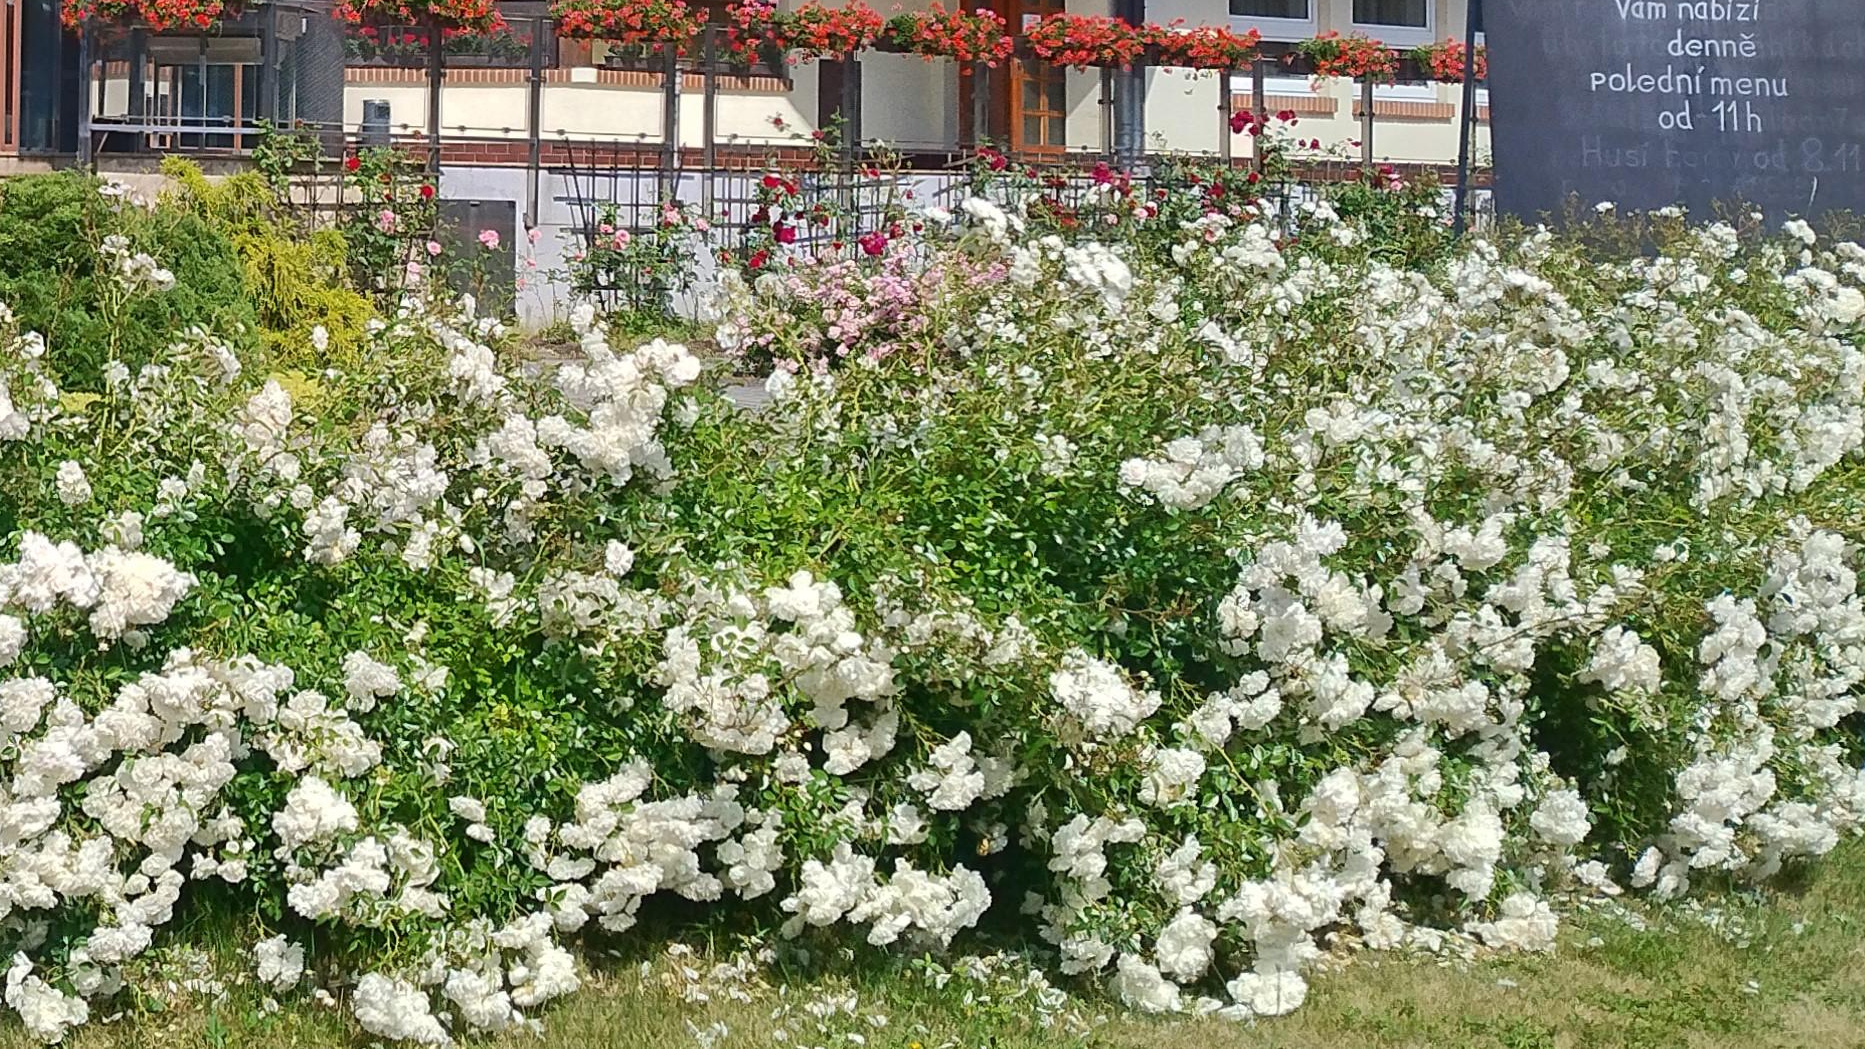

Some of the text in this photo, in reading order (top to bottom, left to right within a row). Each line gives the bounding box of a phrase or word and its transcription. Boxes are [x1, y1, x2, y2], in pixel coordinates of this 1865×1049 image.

[1667, 29, 1757, 58] denně
[1711, 73, 1790, 97] menu
[1658, 101, 1694, 131] od
